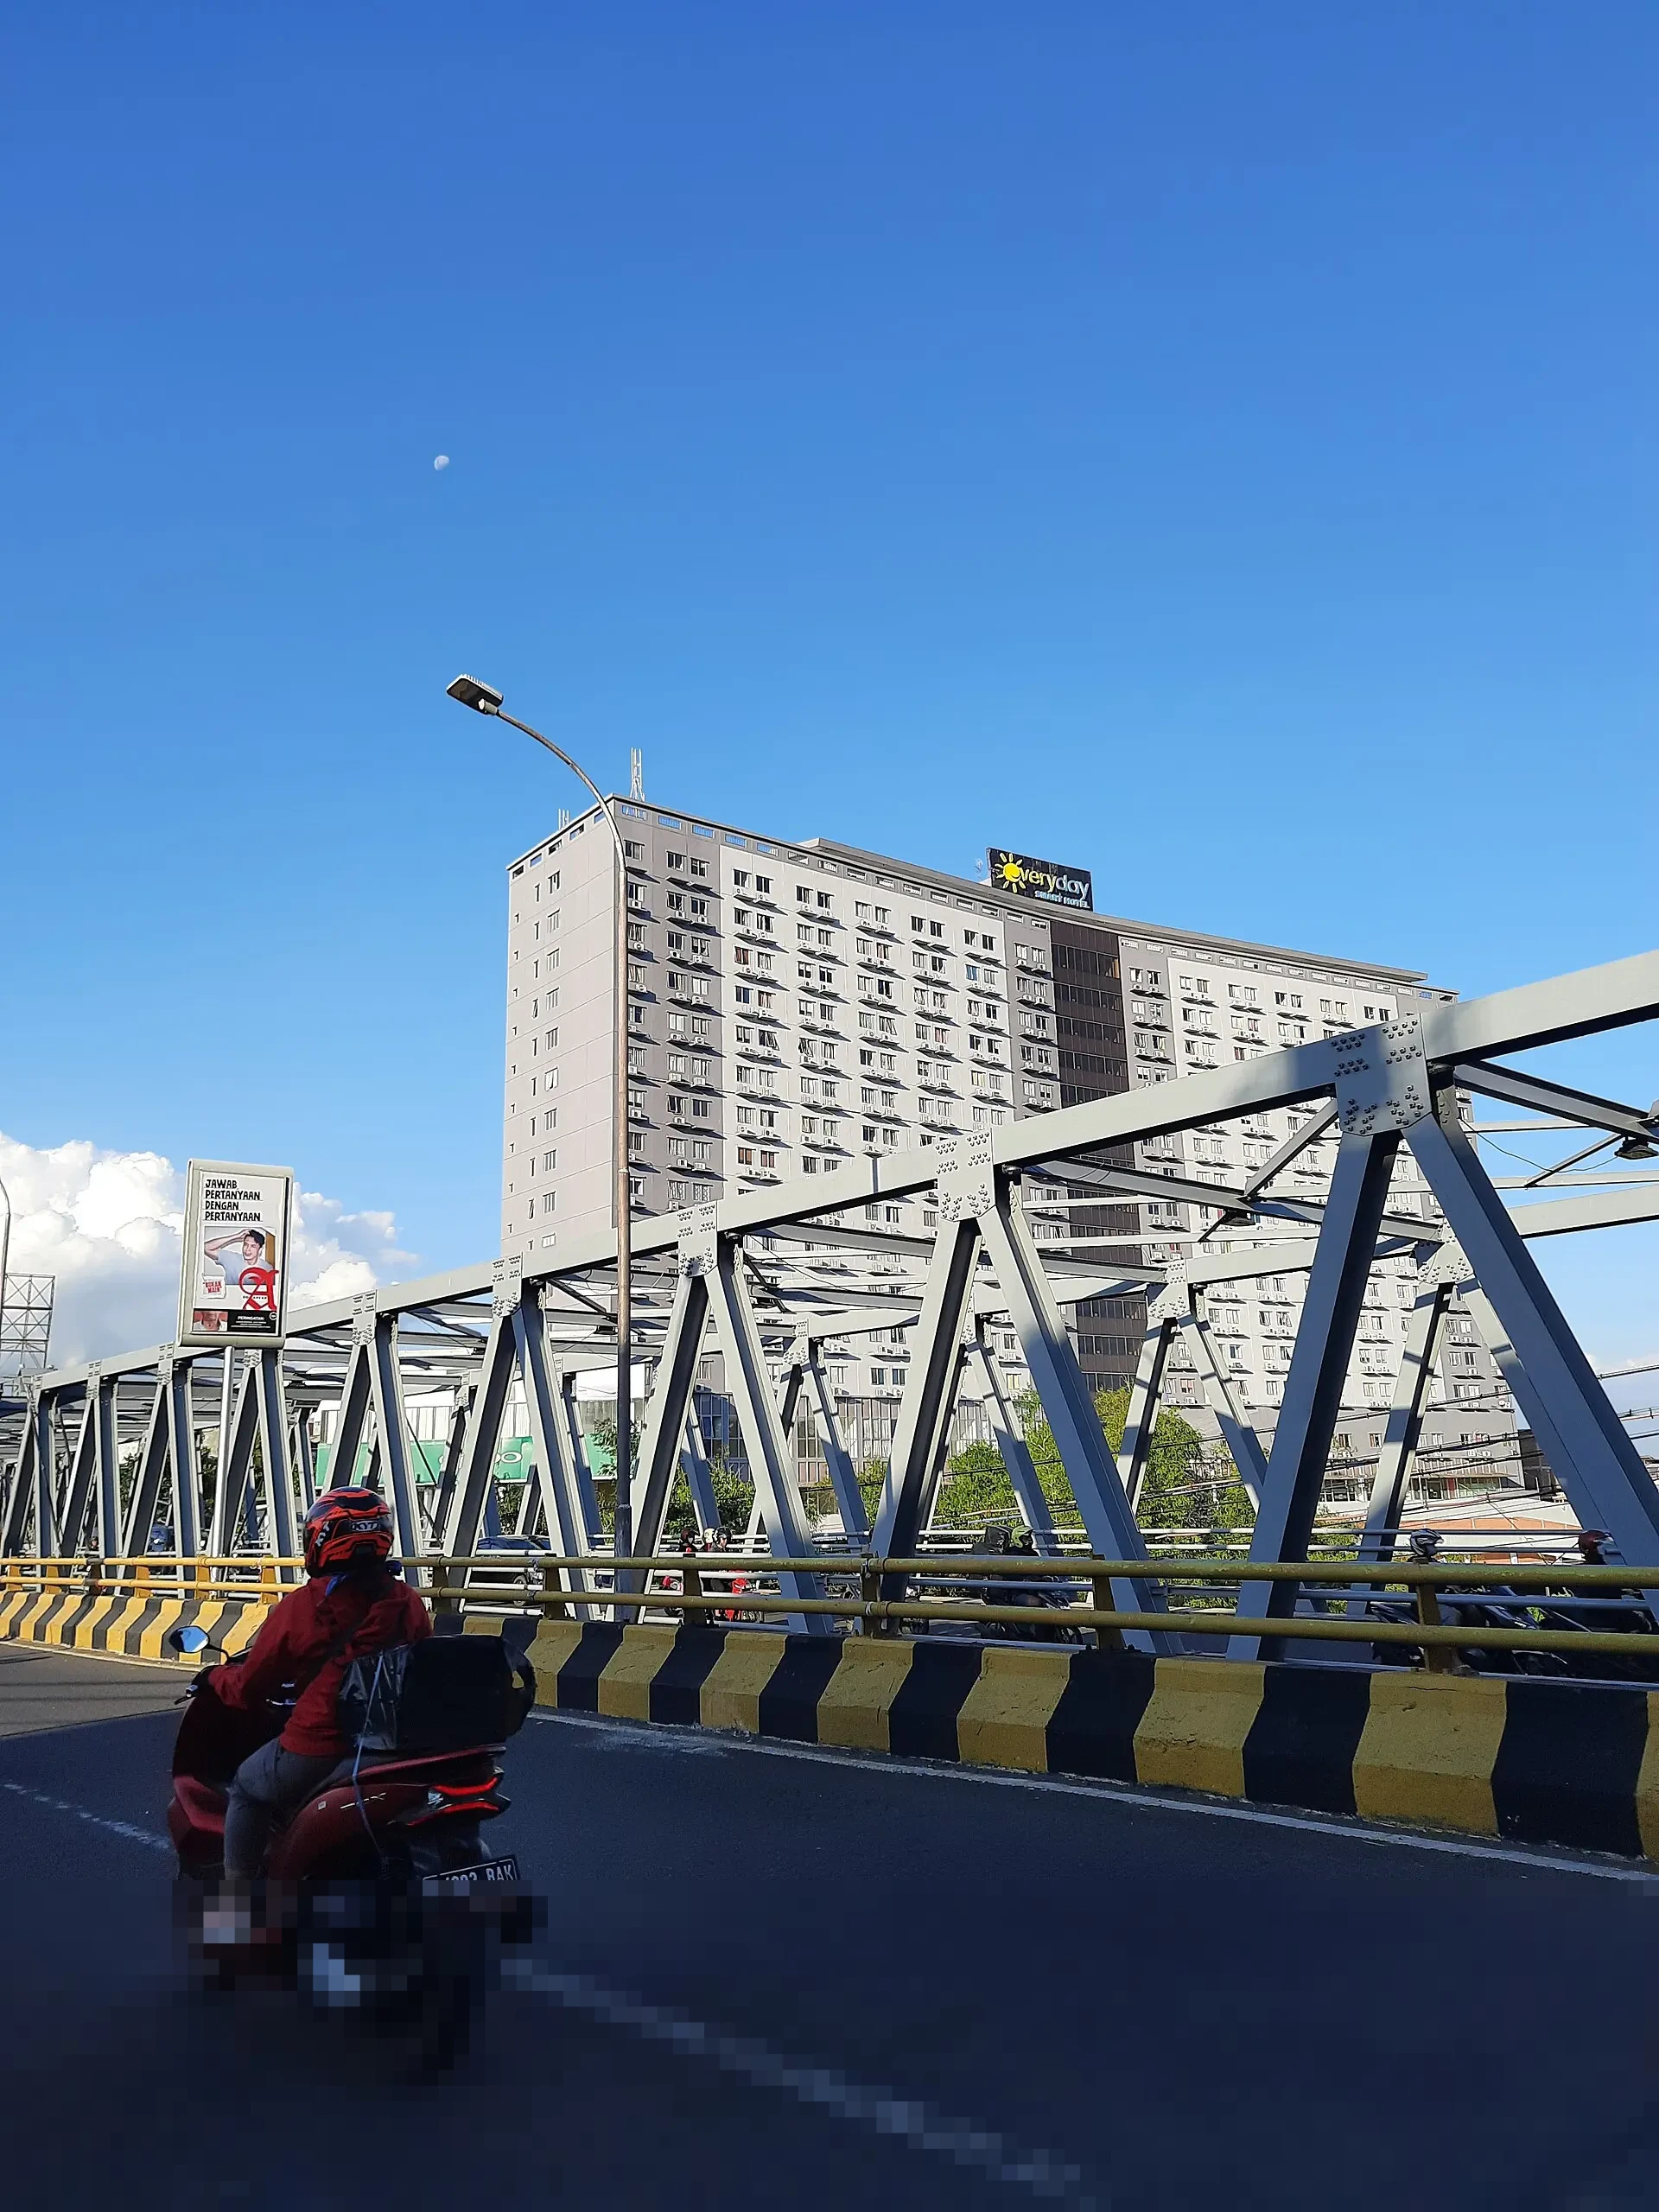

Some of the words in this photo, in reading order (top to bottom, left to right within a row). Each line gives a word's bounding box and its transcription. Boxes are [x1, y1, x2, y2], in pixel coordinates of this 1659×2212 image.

[1034, 890, 1063, 903] SMART
[1063, 896, 1090, 909] HOTEL
[205, 1179, 238, 1189] JAWAB
[205, 1189, 260, 1200] PERTANYAAN
[205, 1200, 239, 1210] DENGAN
[204, 1211, 261, 1221] PERTANYAAN
[352, 1520, 378, 1532] KYT
